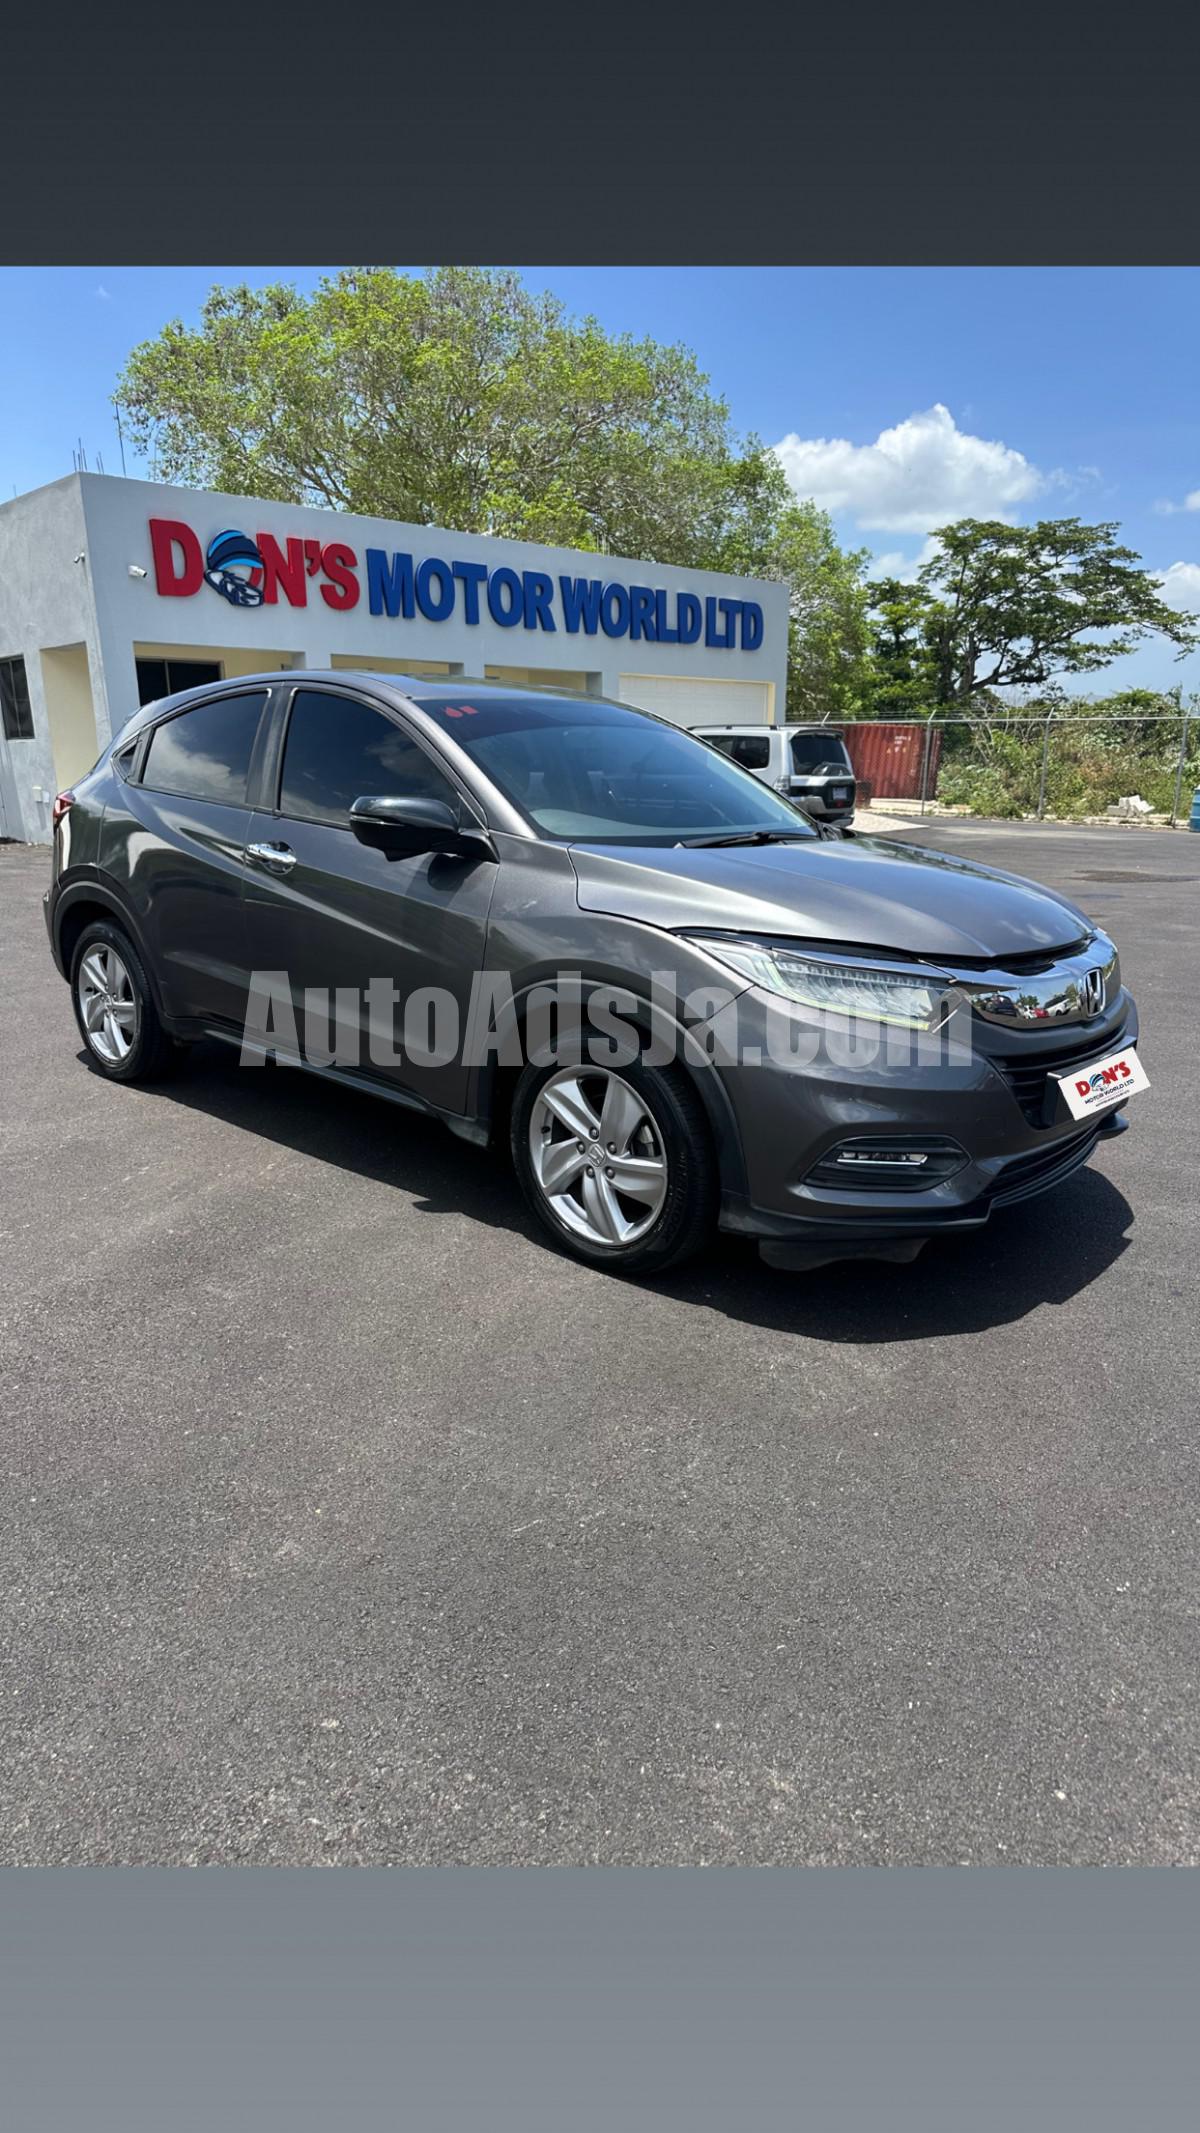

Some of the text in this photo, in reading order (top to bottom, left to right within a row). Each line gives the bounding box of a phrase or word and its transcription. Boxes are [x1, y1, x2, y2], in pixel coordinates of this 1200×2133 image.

[149, 518, 764, 651] DN'S MOTOR WORLD LTD
[1075, 1061, 1131, 1097] DN'S
[1084, 1093, 1104, 1104] MOTOR
[1104, 1083, 1125, 1096] WORLD
[1124, 1078, 1135, 1087] LTD
